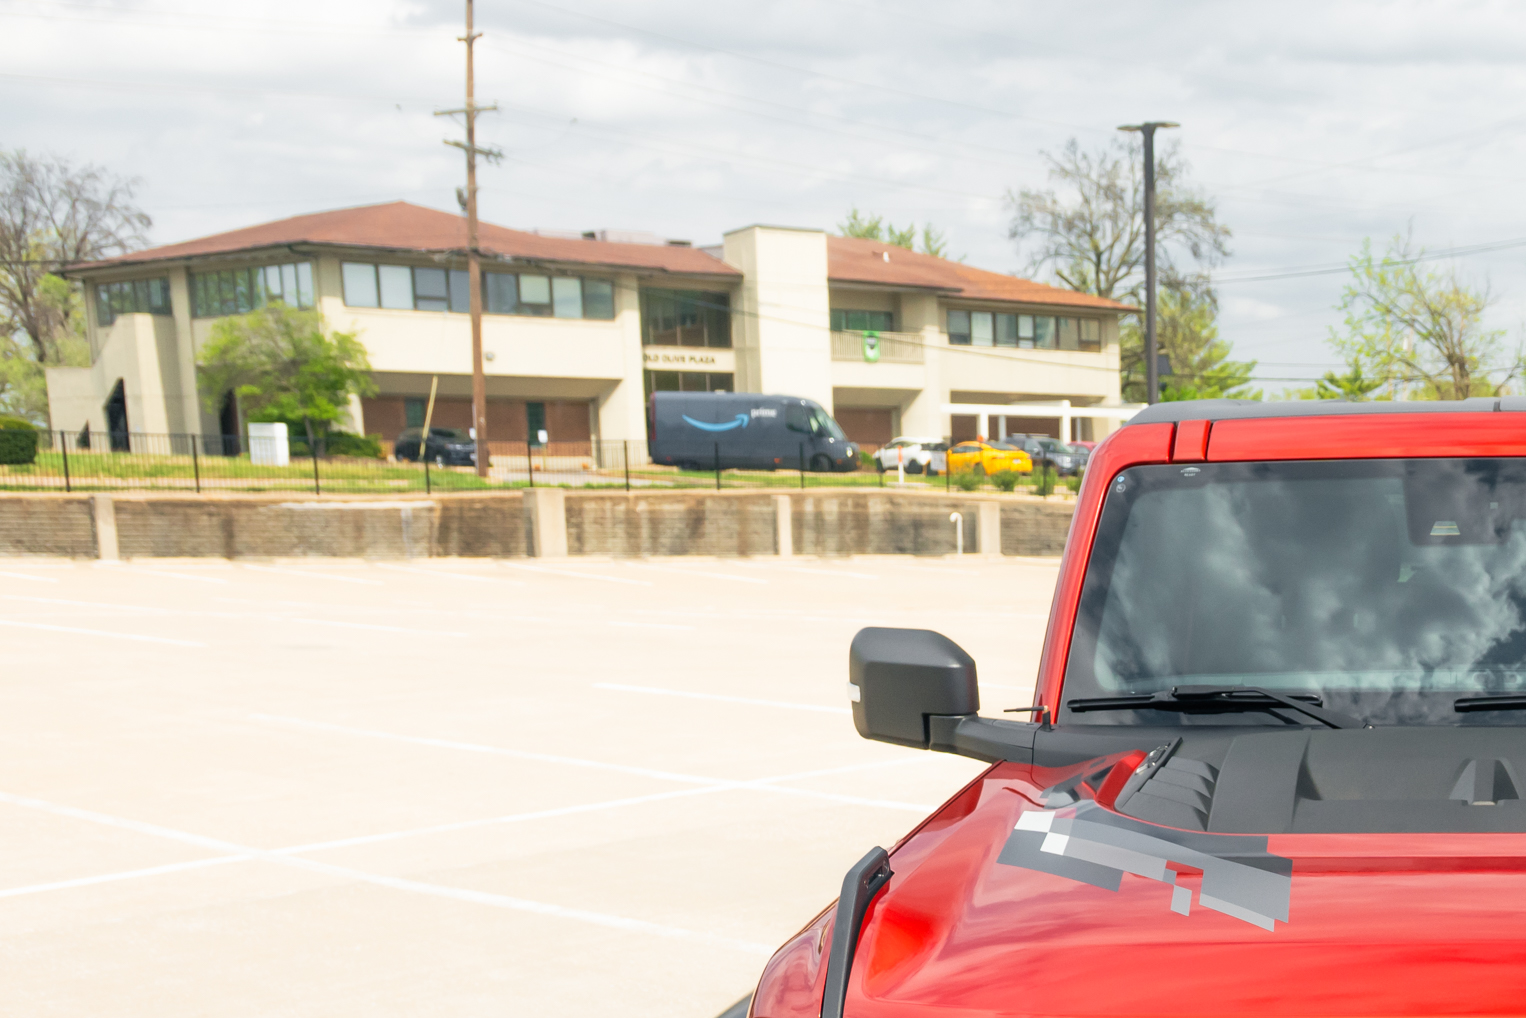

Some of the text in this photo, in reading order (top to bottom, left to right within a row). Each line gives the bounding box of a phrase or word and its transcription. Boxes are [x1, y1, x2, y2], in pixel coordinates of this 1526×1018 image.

[643, 353, 715, 364] OLD OLIVE PLAZA
[750, 407, 777, 419] prime
